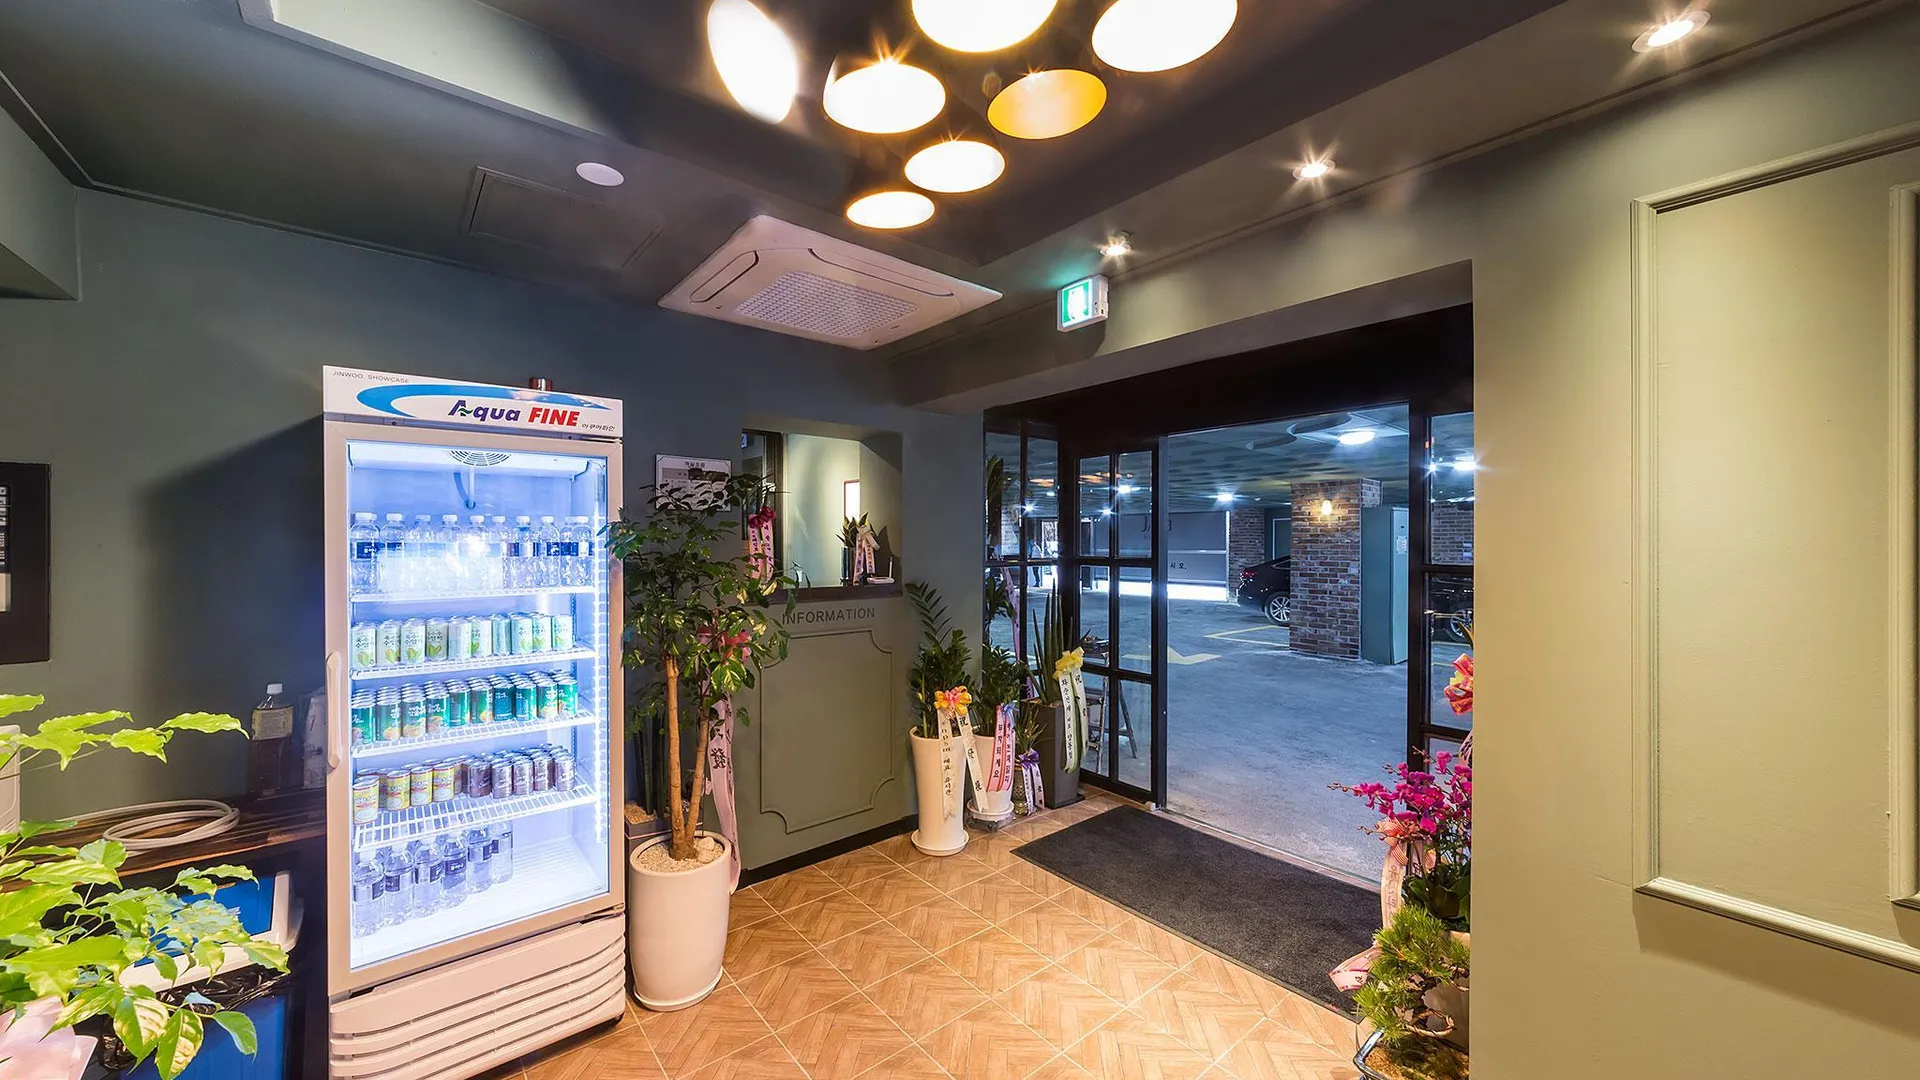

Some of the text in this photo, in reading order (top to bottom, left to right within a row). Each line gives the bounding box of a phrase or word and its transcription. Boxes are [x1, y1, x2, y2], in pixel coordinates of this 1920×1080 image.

[333, 371, 409, 384] JINWOO SHOWCASE
[448, 399, 580, 427] Aqua FINE
[782, 607, 875, 625] INFORMATION
